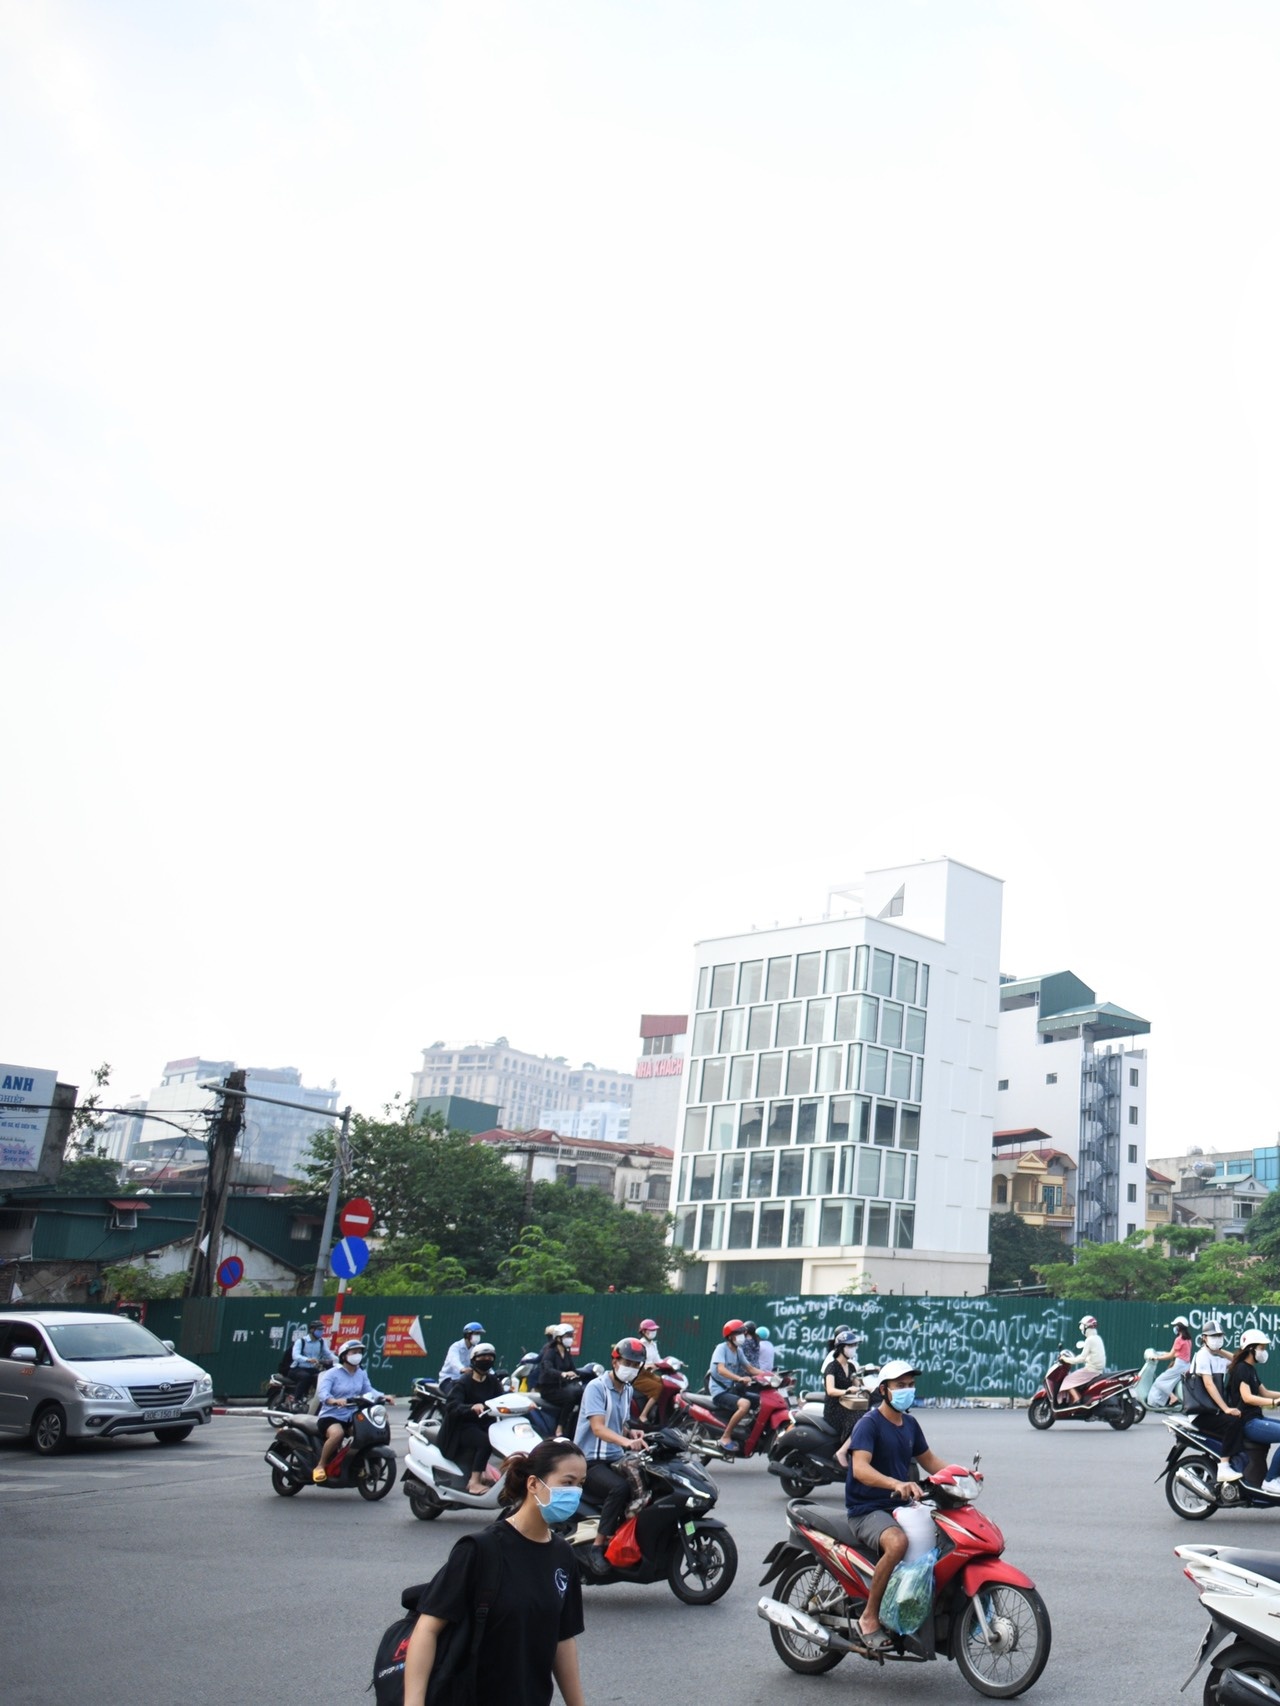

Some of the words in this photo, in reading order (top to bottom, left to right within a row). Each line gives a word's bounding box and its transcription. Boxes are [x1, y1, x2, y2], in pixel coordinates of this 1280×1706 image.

[655, 1056, 683, 1077] KHÁCH
[2, 1075, 34, 1092] ANH
[1189, 1308, 1233, 1330] CHIM
